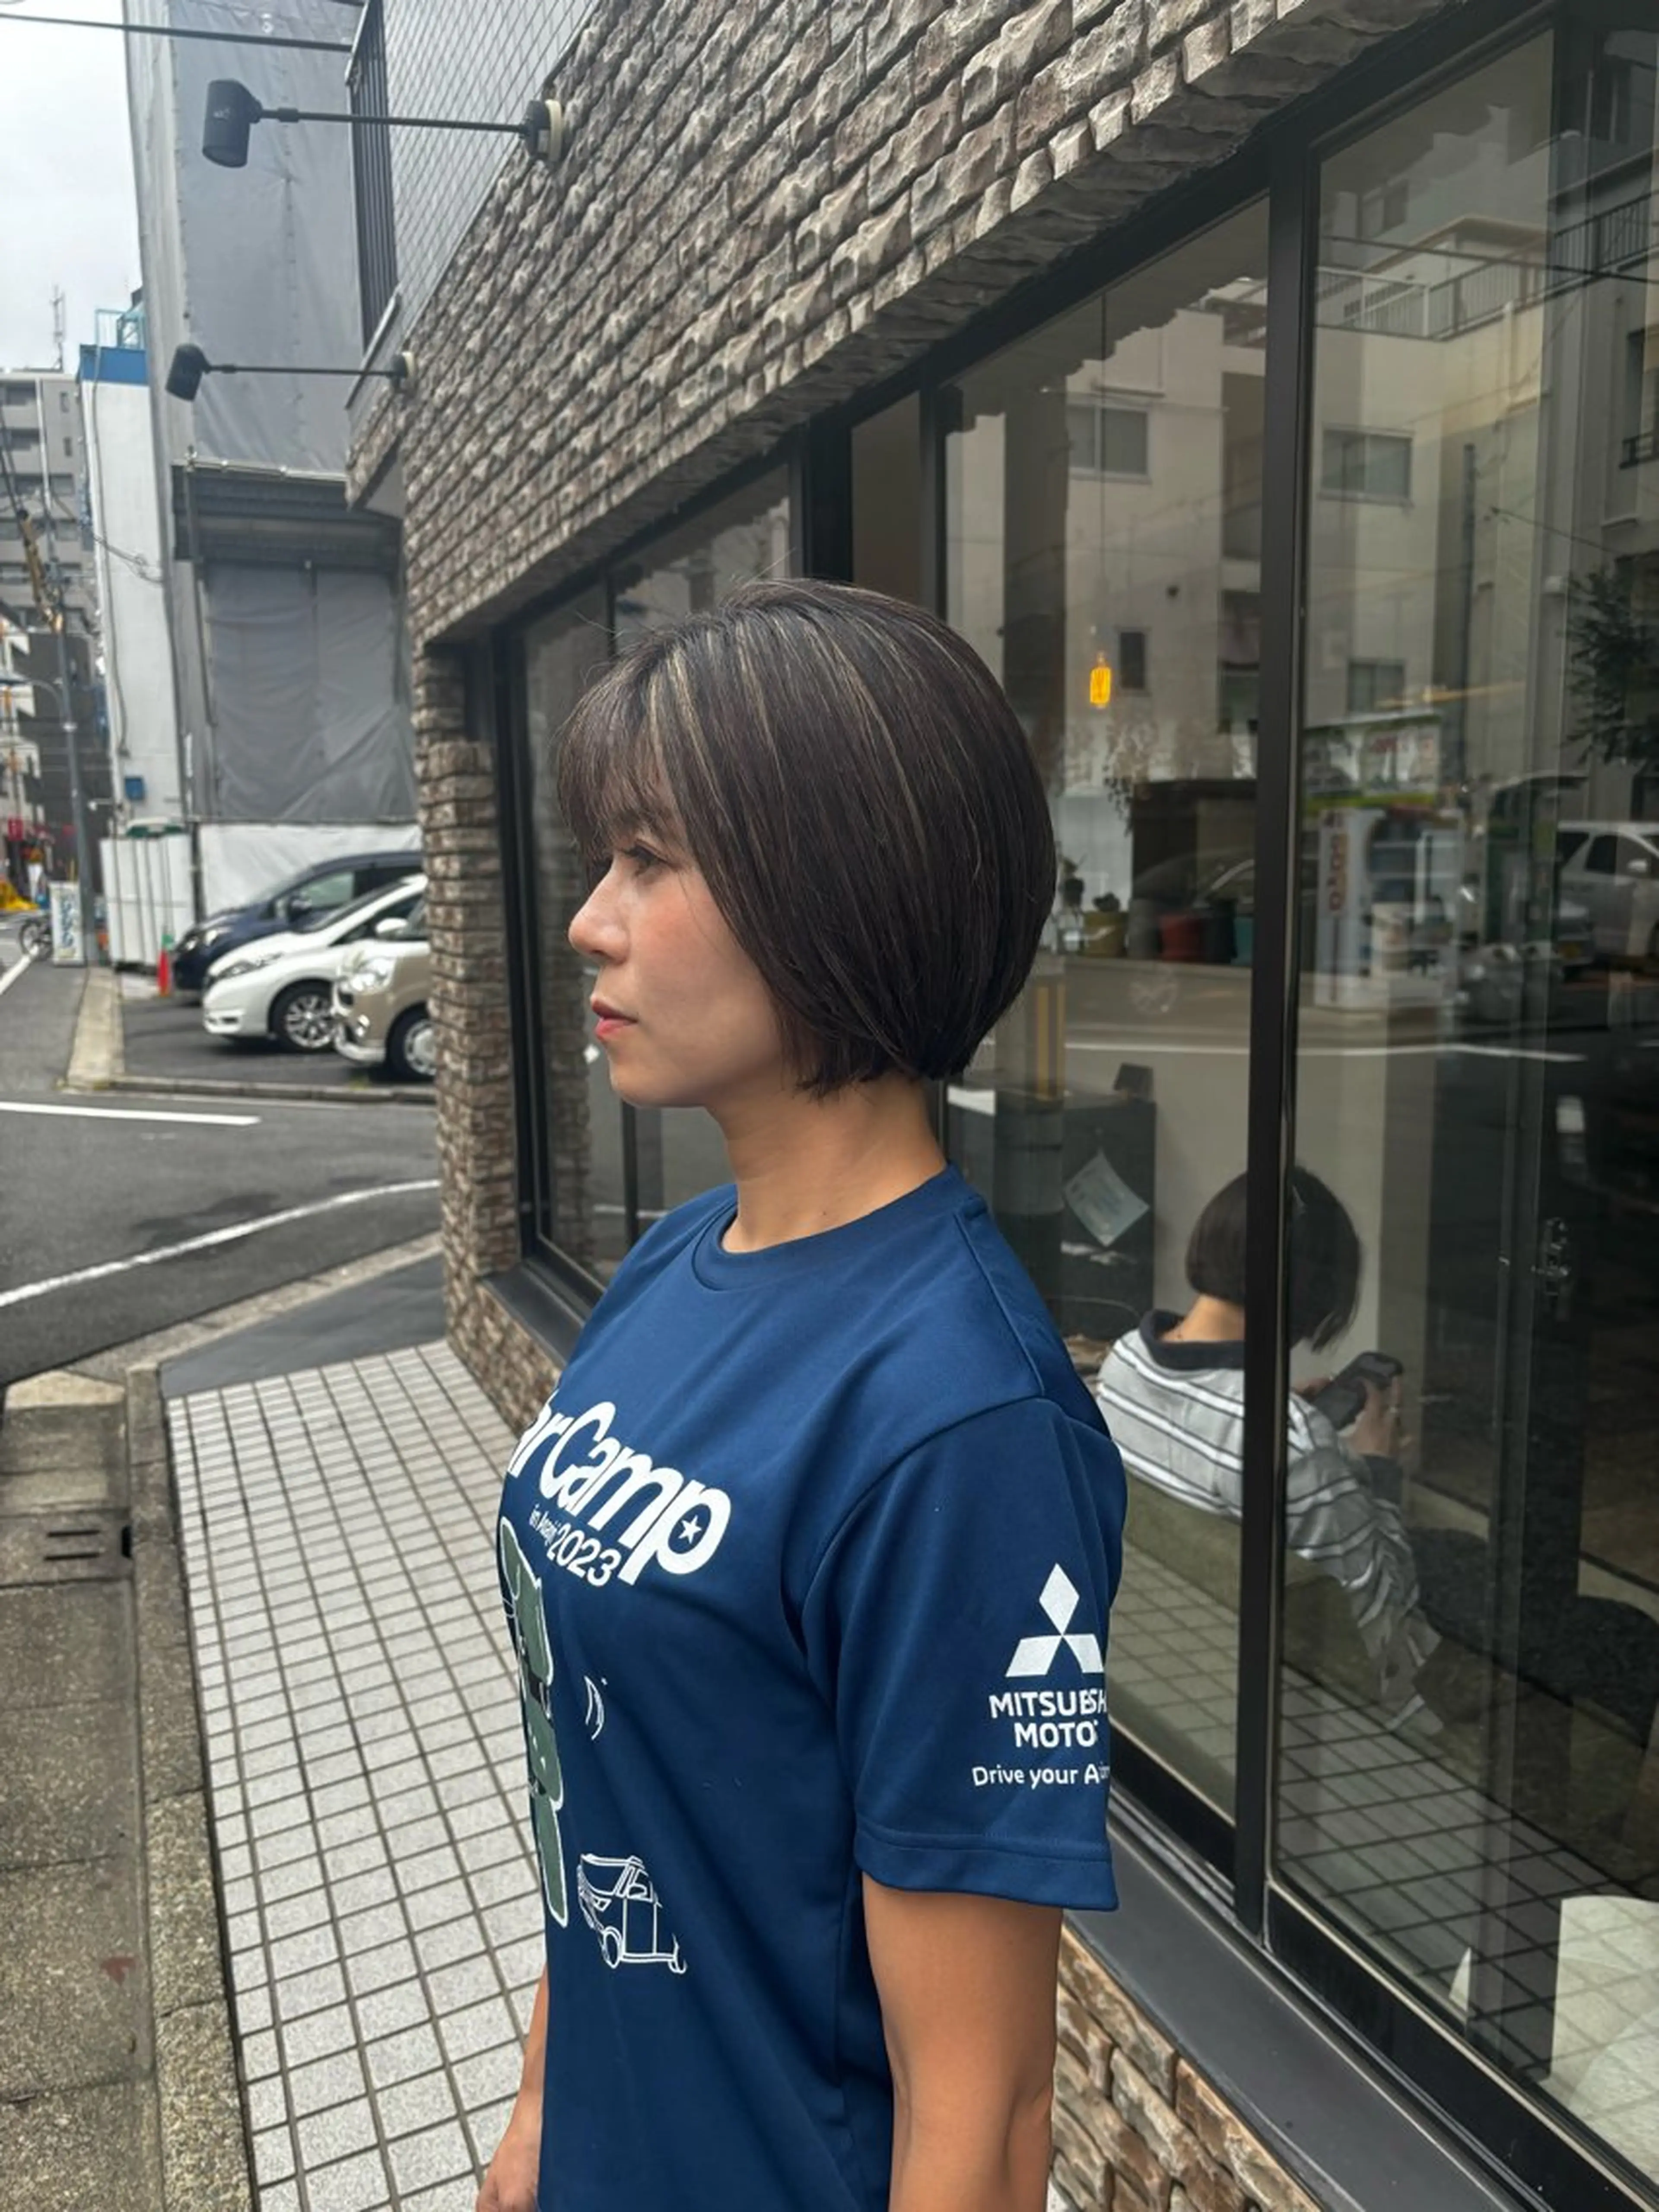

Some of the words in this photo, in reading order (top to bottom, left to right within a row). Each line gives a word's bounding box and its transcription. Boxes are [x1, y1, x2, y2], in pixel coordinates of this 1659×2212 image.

[546, 1522, 622, 1587] 2023
[1014, 1719, 1099, 1748] MOTO
[971, 1764, 1025, 1786] Drive
[1030, 1767, 1078, 1790] your
